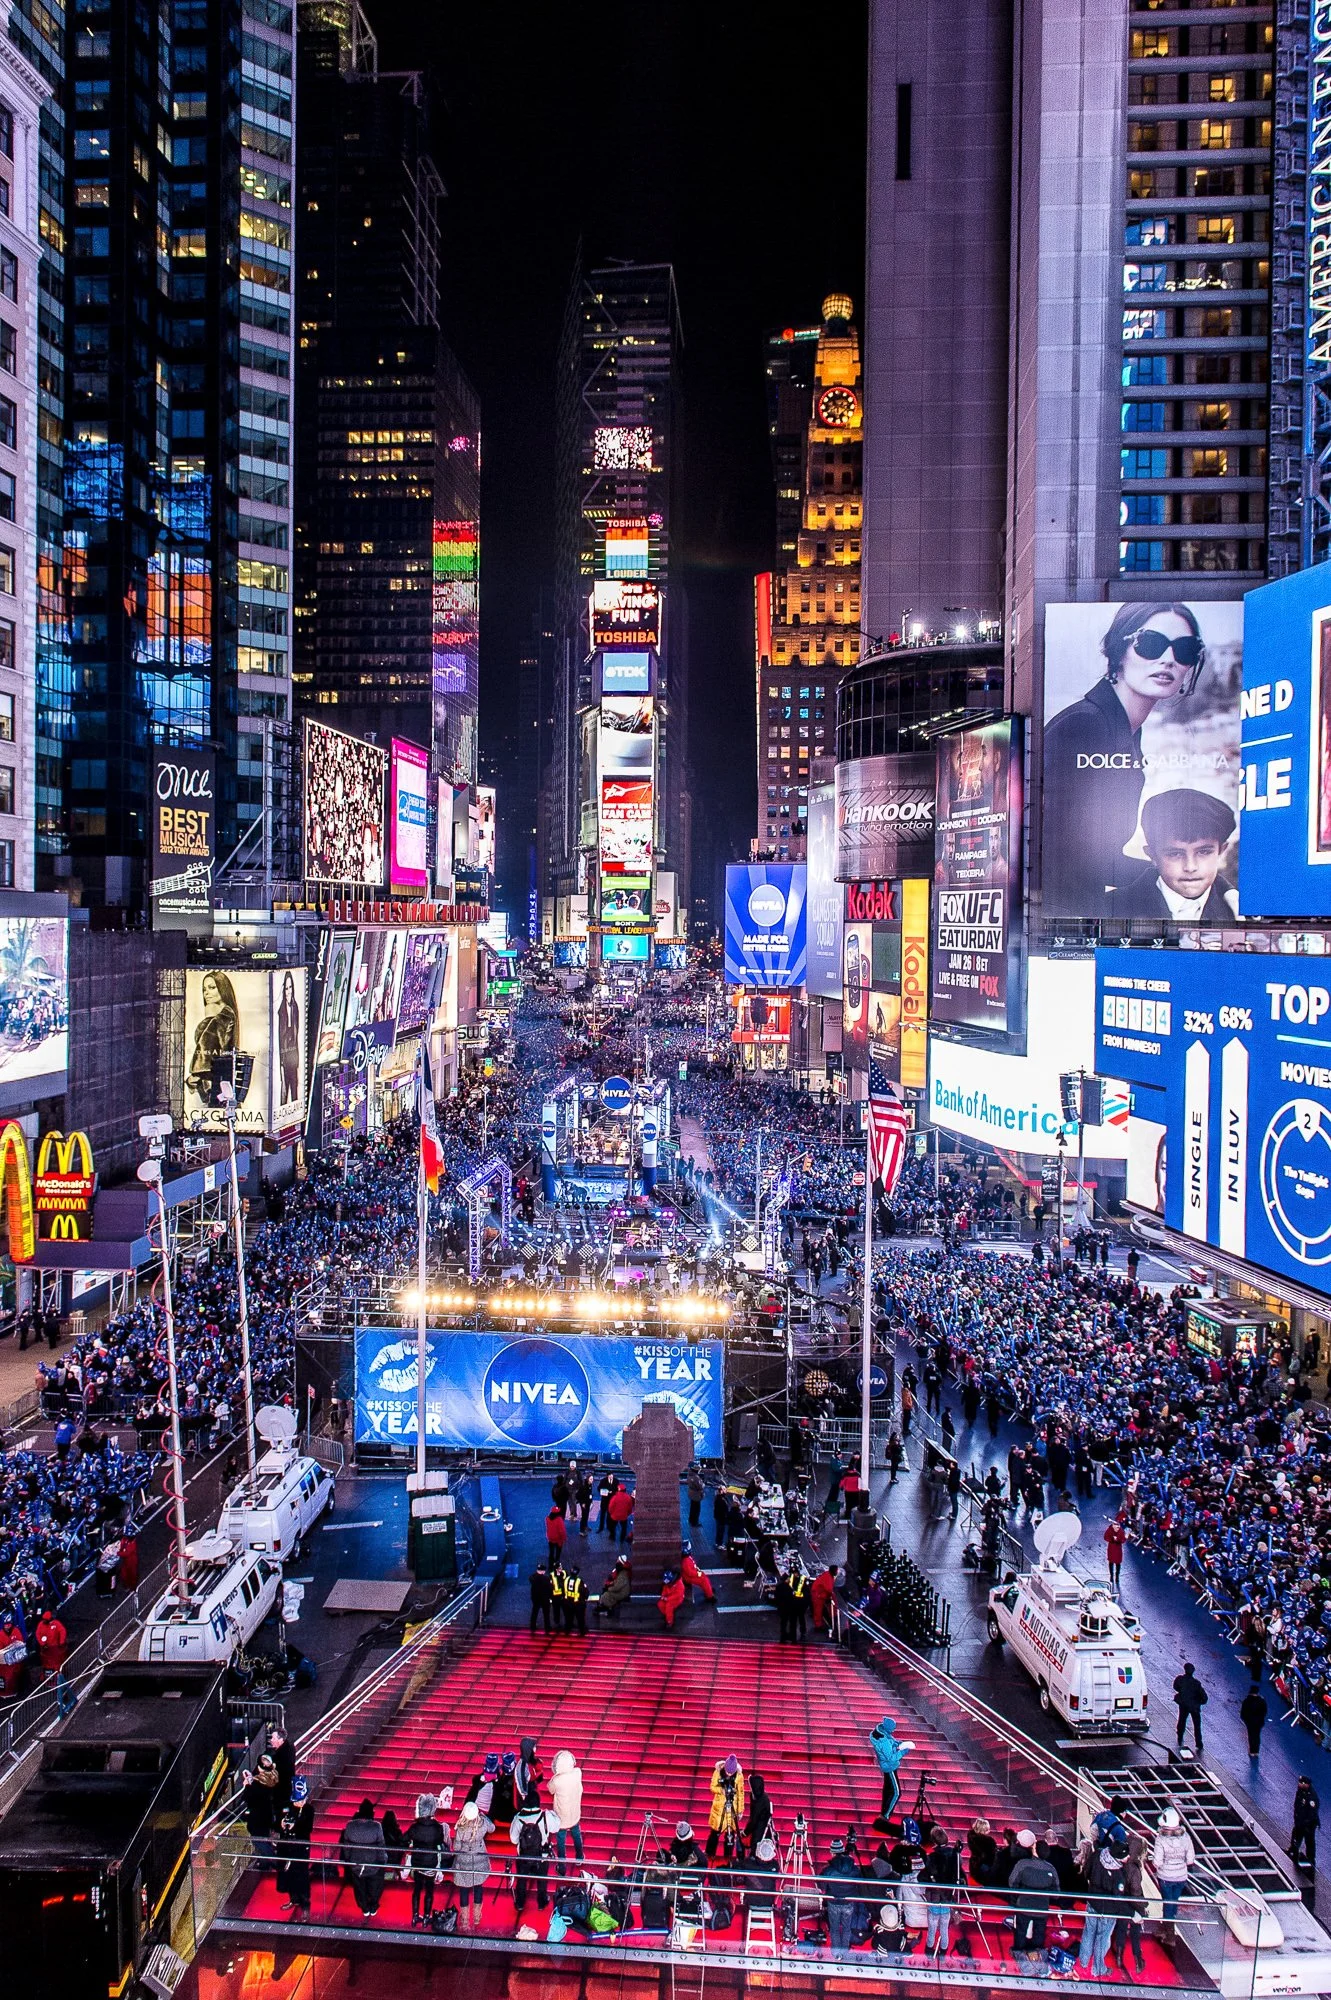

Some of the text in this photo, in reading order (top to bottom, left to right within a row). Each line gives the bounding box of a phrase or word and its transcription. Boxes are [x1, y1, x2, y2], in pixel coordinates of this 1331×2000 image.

[606, 519, 648, 528] TOSHIBA
[606, 569, 647, 579] LOUDER
[611, 609, 640, 622] FUN
[594, 631, 657, 643] TOSHIBA
[617, 666, 646, 678] TDK
[1076, 752, 1230, 769] DOLCE & GABBANA
[159, 807, 210, 834] BEST
[883, 821, 933, 831] emotion
[937, 819, 969, 830] JOHNSON
[977, 812, 1007, 826] DODSON
[159, 831, 210, 848] MUSICAL
[159, 846, 210, 857] 2012 TONY AWARD
[954, 850, 988, 860] RAMPAGE
[848, 882, 895, 920] Kodak
[940, 891, 1002, 924] FOX UFC
[743, 934, 769, 944] MADE
[939, 929, 1002, 950] SATURDAY
[948, 953, 962, 970] JAN
[962, 954, 972, 971] 26
[903, 936, 925, 1034] Kodak
[938, 972, 951, 985] LIVE
[955, 974, 970, 988] FREE
[970, 975, 979, 989] ON
[979, 974, 1000, 997] FOX
[1265, 986, 1330, 1026] TOP
[1183, 1005, 1253, 1035] 32% 68%
[1102, 1033, 1124, 1049] FROM
[1280, 1061, 1331, 1089] MOVIE
[602, 1089, 631, 1098] NIVEA
[935, 1079, 1079, 1135] Bank of America
[1303, 1112, 1312, 1129] 2
[1191, 1110, 1203, 1209] SINGLE
[1228, 1109, 1241, 1203] IN LUV
[36, 1179, 92, 1189] McDonald's
[635, 1356, 713, 1380] YEAR
[491, 1379, 581, 1406] NIVEA
[367, 1411, 444, 1435] YEAR
[1029, 1613, 1060, 1657] NOTICIAS
[1058, 1648, 1069, 1667] 41
[1082, 1697, 1088, 1706] 3
[1272, 1985, 1302, 1994] verizon
